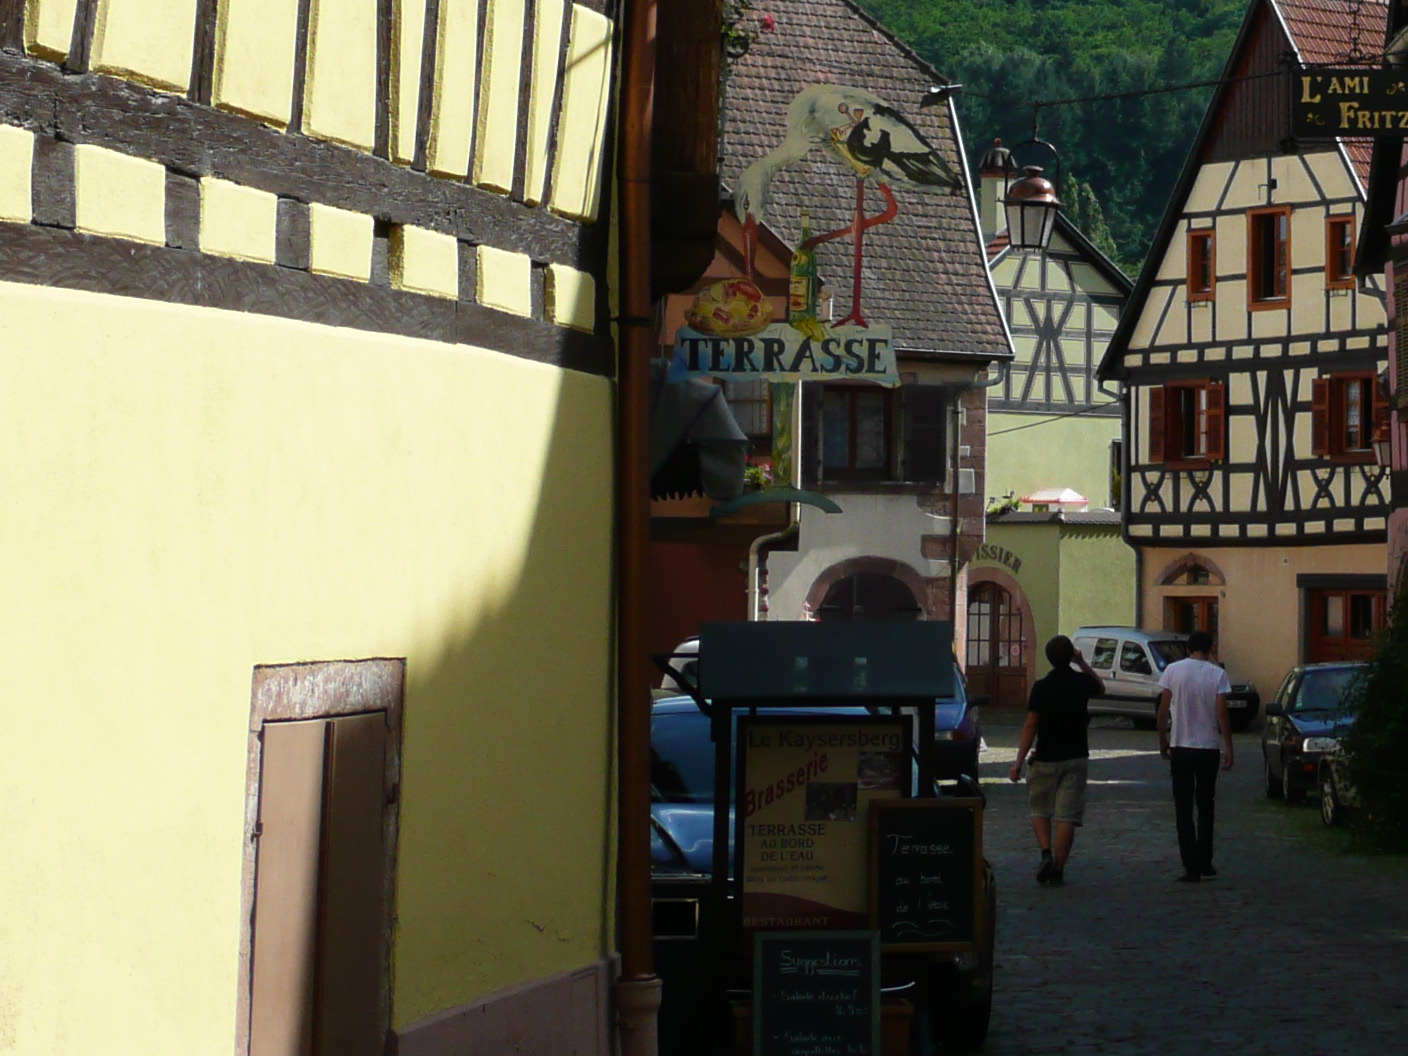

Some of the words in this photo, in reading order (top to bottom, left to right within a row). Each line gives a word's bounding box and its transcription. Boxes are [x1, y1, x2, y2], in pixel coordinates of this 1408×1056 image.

[1300, 75, 1370, 104] L'AMI
[681, 337, 888, 374] TERRASSE
[972, 543, 1022, 575] ISSIER
[748, 730, 770, 748] Le
[779, 729, 901, 752] Kaysersberg
[743, 750, 829, 818] Brasserie
[751, 823, 826, 837] TERRASSE
[760, 838, 776, 849] AU
[781, 838, 814, 849] BORD
[761, 851, 776, 861] DE
[743, 917, 831, 927] RESTAURANT
